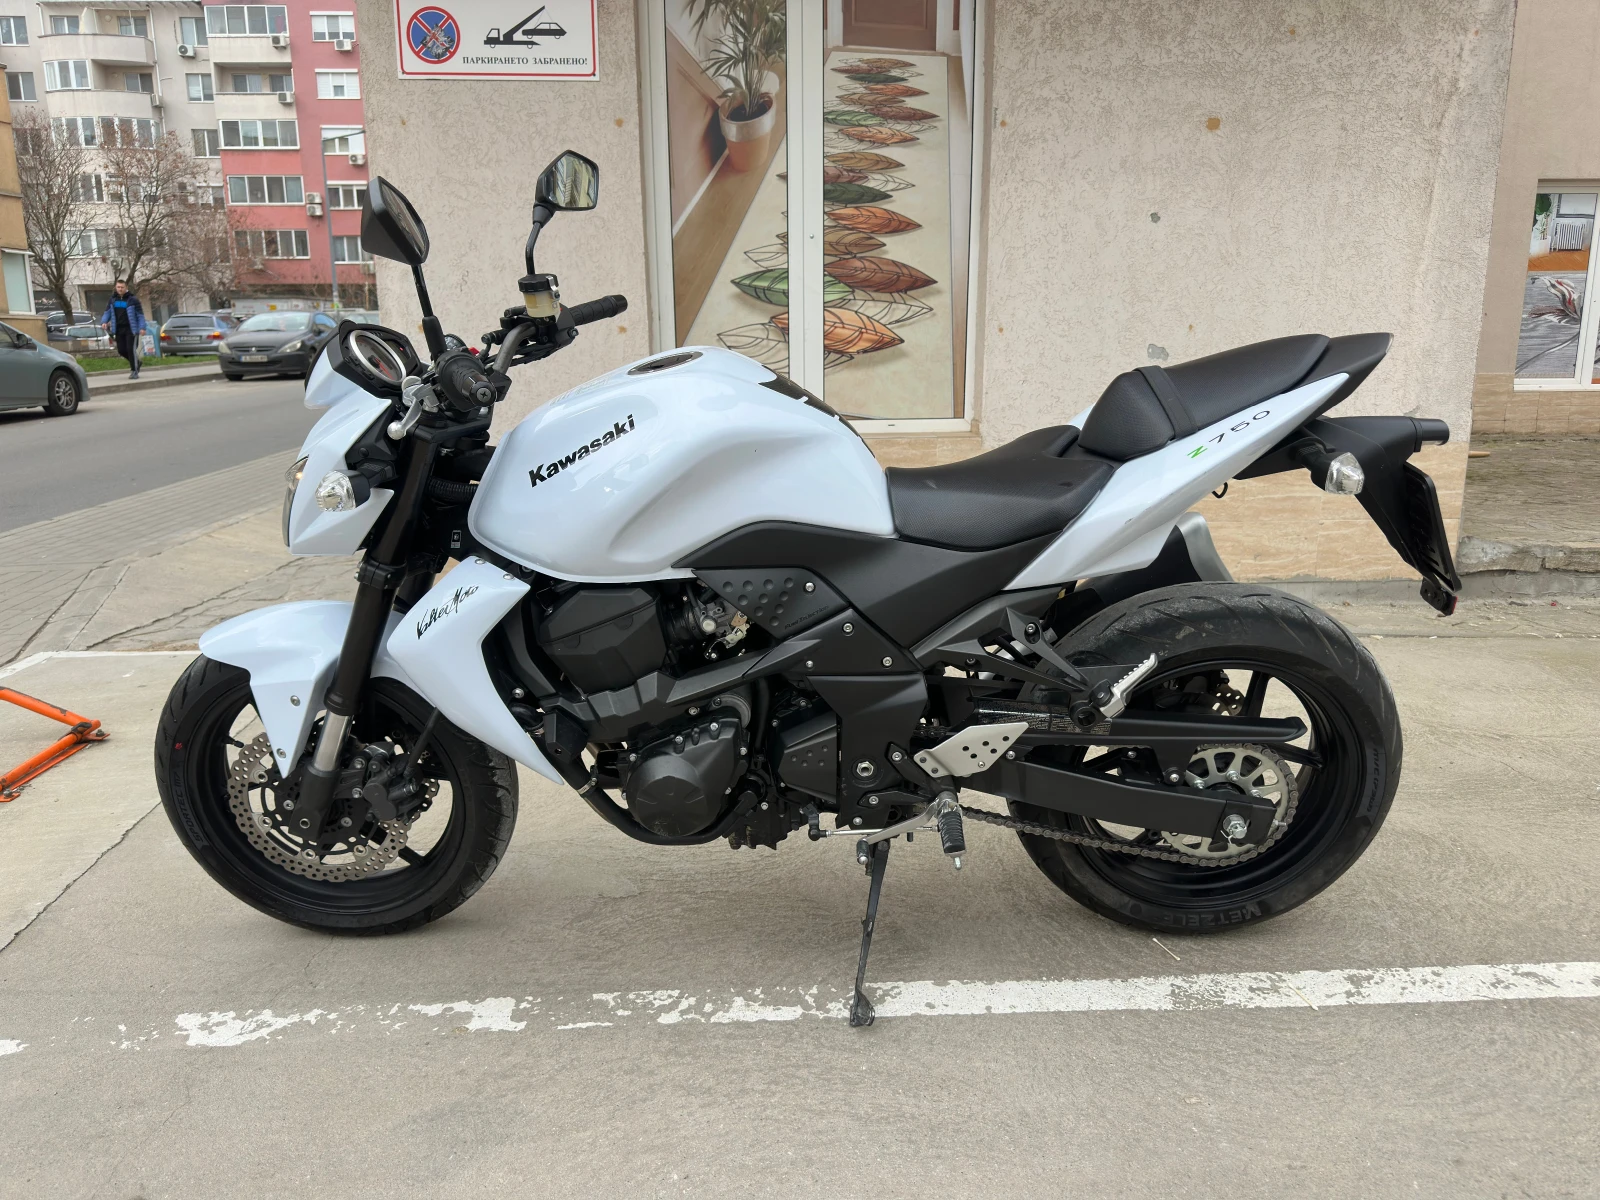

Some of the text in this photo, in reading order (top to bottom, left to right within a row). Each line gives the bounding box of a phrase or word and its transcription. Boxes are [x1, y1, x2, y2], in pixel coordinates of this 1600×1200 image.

[462, 56, 588, 66] ПАРКИРАНЕТО ЗАБРАНЕНО!
[528, 413, 636, 488] Kawasaki
